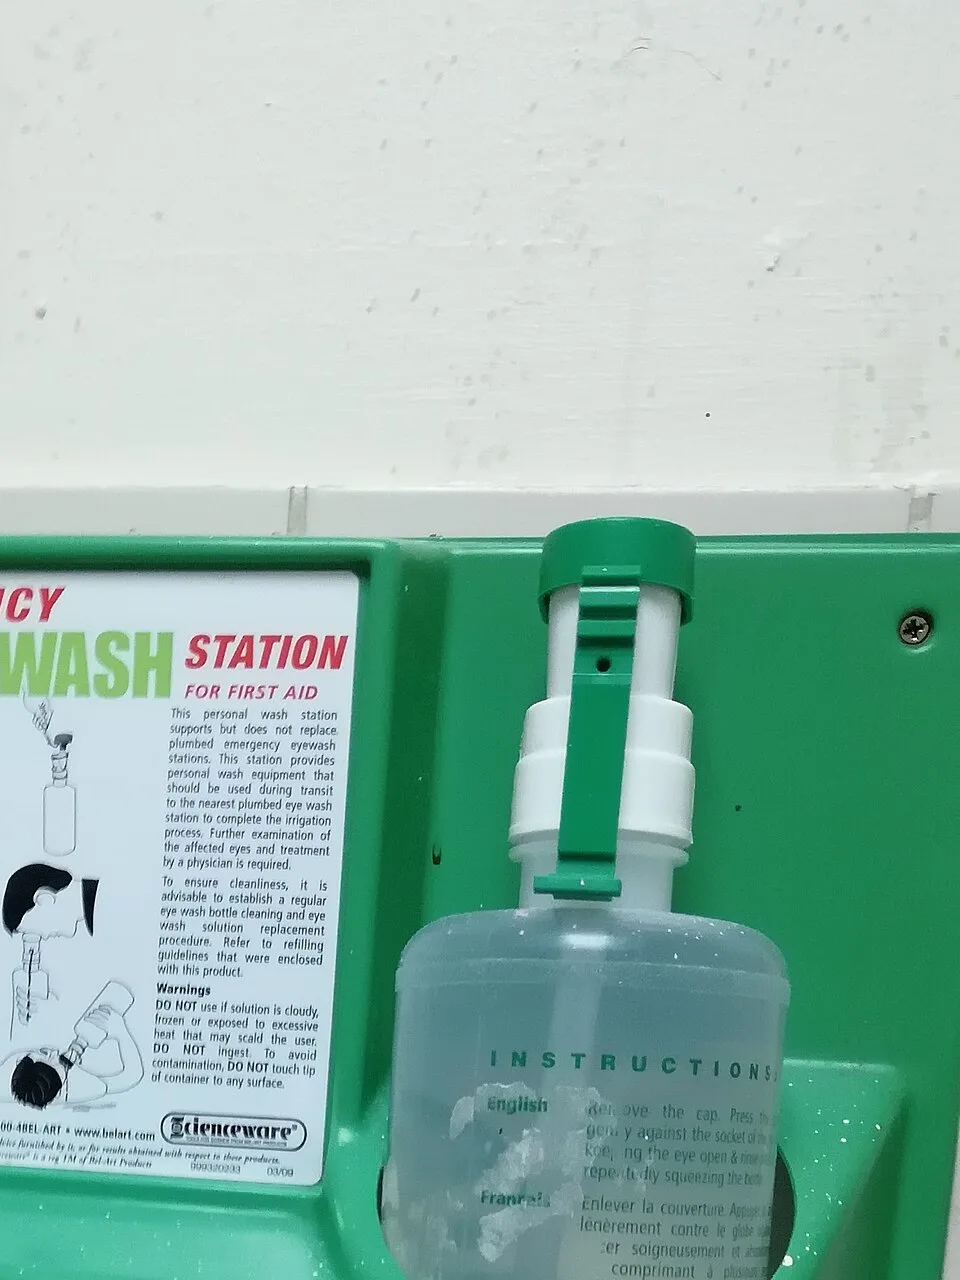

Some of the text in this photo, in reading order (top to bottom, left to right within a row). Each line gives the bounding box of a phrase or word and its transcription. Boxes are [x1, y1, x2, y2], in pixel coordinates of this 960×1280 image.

[184, 634, 349, 670] STATION
[184, 684, 318, 700] FOR FIRST AID
[171, 707, 338, 722] This personal wash station
[170, 722, 337, 738] supports but does not replace
[168, 737, 336, 753] plumbed emergency eyewash
[218, 752, 238, 765] This
[246, 753, 282, 765] station
[289, 754, 335, 768] provides
[167, 766, 334, 783] personal wash equipment that
[167, 781, 333, 798] should be used during transit
[166, 796, 332, 813] to the nearest plumbed eye wash
[165, 811, 331, 829] station to complete the irrigation
[209, 826, 245, 839] Further
[251, 828, 314, 841] examination
[320, 828, 331, 841] of
[164, 840, 330, 857] the affected eyes and treatment
[162, 855, 291, 872] by a physician is required.
[162, 875, 327, 892] To ensure cleanliness, it is
[160, 890, 327, 909] advisable to establish a regular
[160, 905, 326, 924] eye wash bottle cleaning and eye
[159, 920, 325, 937] wash solution replacement
[223, 936, 250, 948] Refer
[262, 938, 272, 949] to
[283, 938, 324, 954] refilling
[157, 949, 323, 966] guidelines that were enclosed
[157, 963, 179, 975] with
[182, 963, 200, 976] this
[156, 982, 211, 998] Warnings
[155, 998, 172, 1011] DO
[175, 999, 198, 1012] NOT
[200, 1003, 217, 1012] use
[220, 1000, 228, 1013] if
[230, 1002, 270, 1015] solution
[273, 1003, 281, 1015] is
[154, 1013, 318, 1032] frozen or exposed to excessive
[153, 1027, 175, 1040] heat
[183, 1028, 202, 1041] that
[209, 1032, 230, 1046] may
[238, 1031, 263, 1044] scald
[270, 1032, 287, 1045] the
[153, 1041, 169, 1054] DO
[183, 1042, 206, 1056] NOT
[265, 1047, 275, 1059] To
[288, 1049, 317, 1061] avoid
[227, 1060, 244, 1072] DO
[246, 1060, 269, 1073] NOT
[272, 1062, 300, 1075] touch
[302, 1064, 316, 1078] tip
[151, 1071, 162, 1083] of
[164, 1072, 209, 1084] container
[213, 1074, 223, 1086] to
[225, 1077, 244, 1090] any
[662, 1104, 685, 1119] the
[637, 1127, 688, 1142] against
[674, 1150, 697, 1164] eye
[581, 1196, 636, 1213] Enlever
[671, 1223, 709, 1238] contre
[611, 1262, 695, 1280] comprimant
